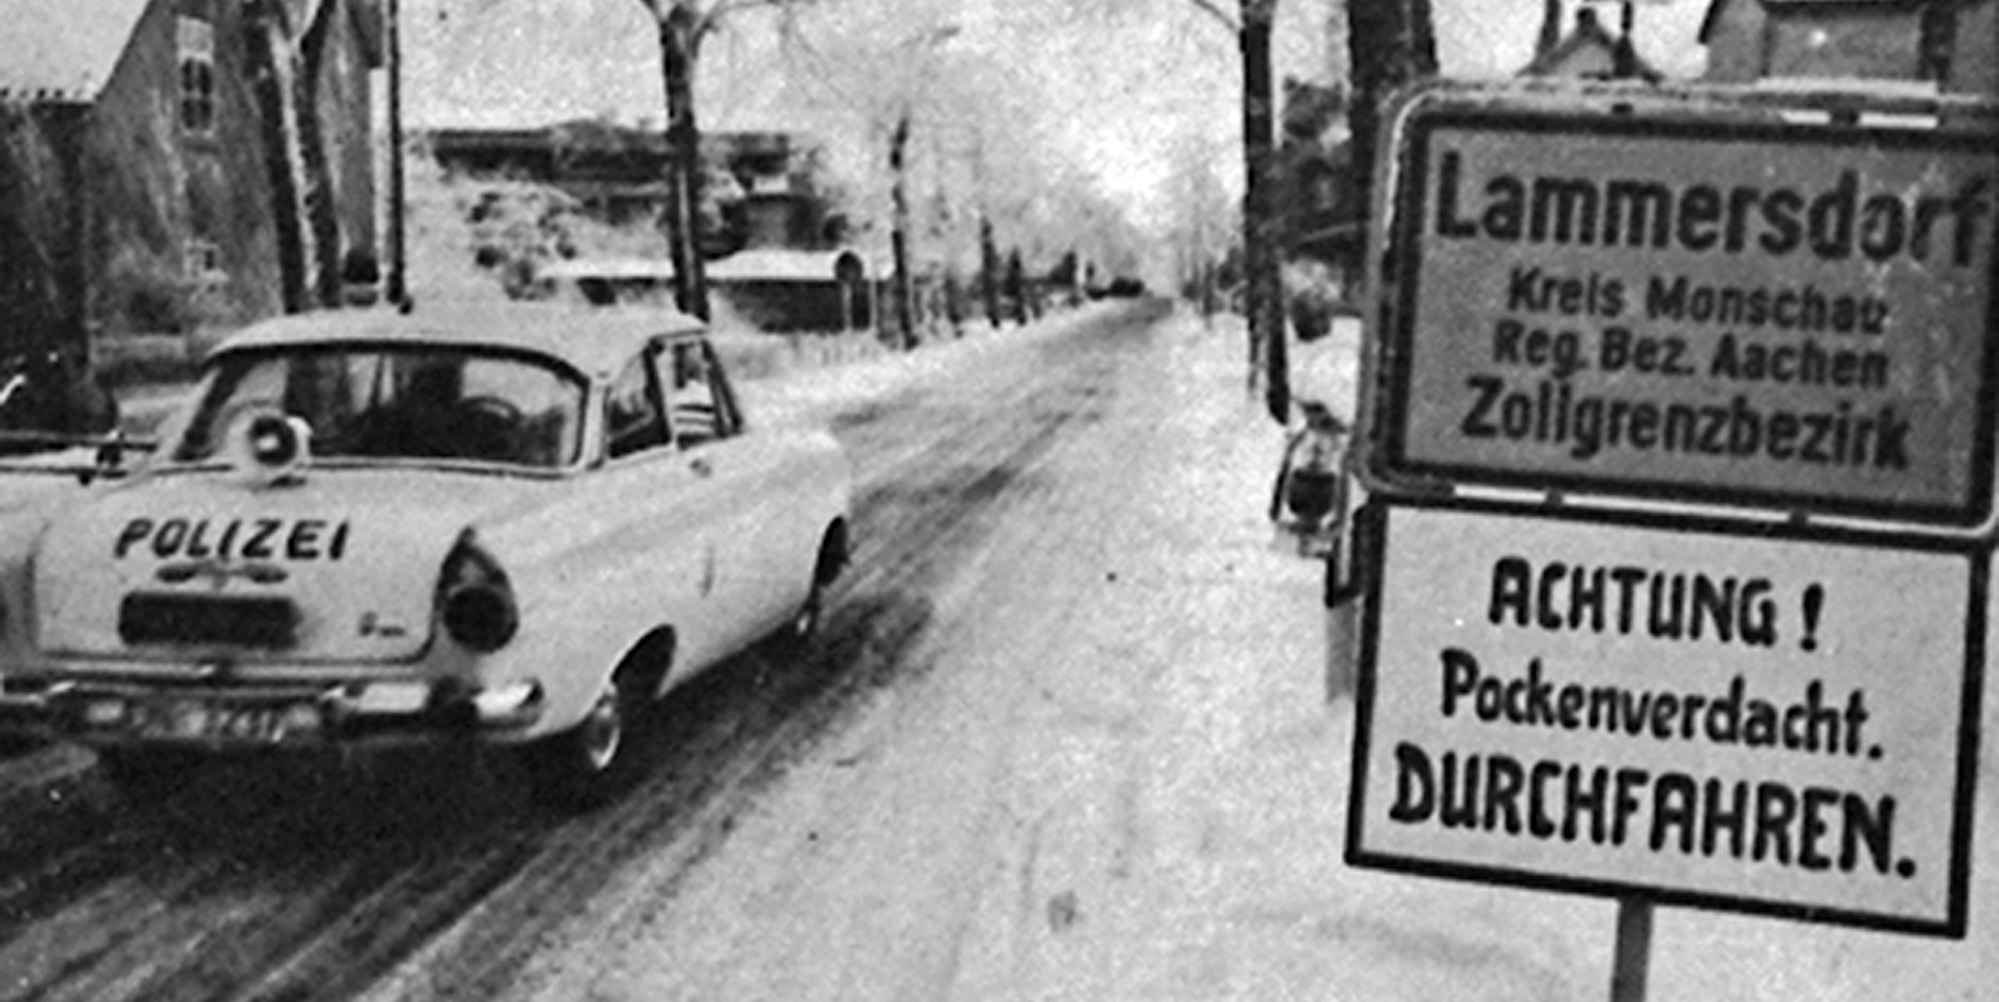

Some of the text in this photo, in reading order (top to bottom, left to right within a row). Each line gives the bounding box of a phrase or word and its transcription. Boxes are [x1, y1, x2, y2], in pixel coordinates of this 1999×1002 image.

[1435, 149, 1990, 267] Lammersdorf
[1505, 267, 1890, 335] Kreis Monschau
[1599, 327, 1695, 377] Bez.
[1710, 333, 1890, 388] Aachen
[1461, 375, 1910, 470] Zollgrenzbezirk
[115, 519, 350, 560] POLIZEI
[1488, 556, 1777, 647] ACHTUNG
[1440, 647, 1883, 760] Pockenverdacht.
[1387, 741, 1916, 878] DURCHFAHREN.
